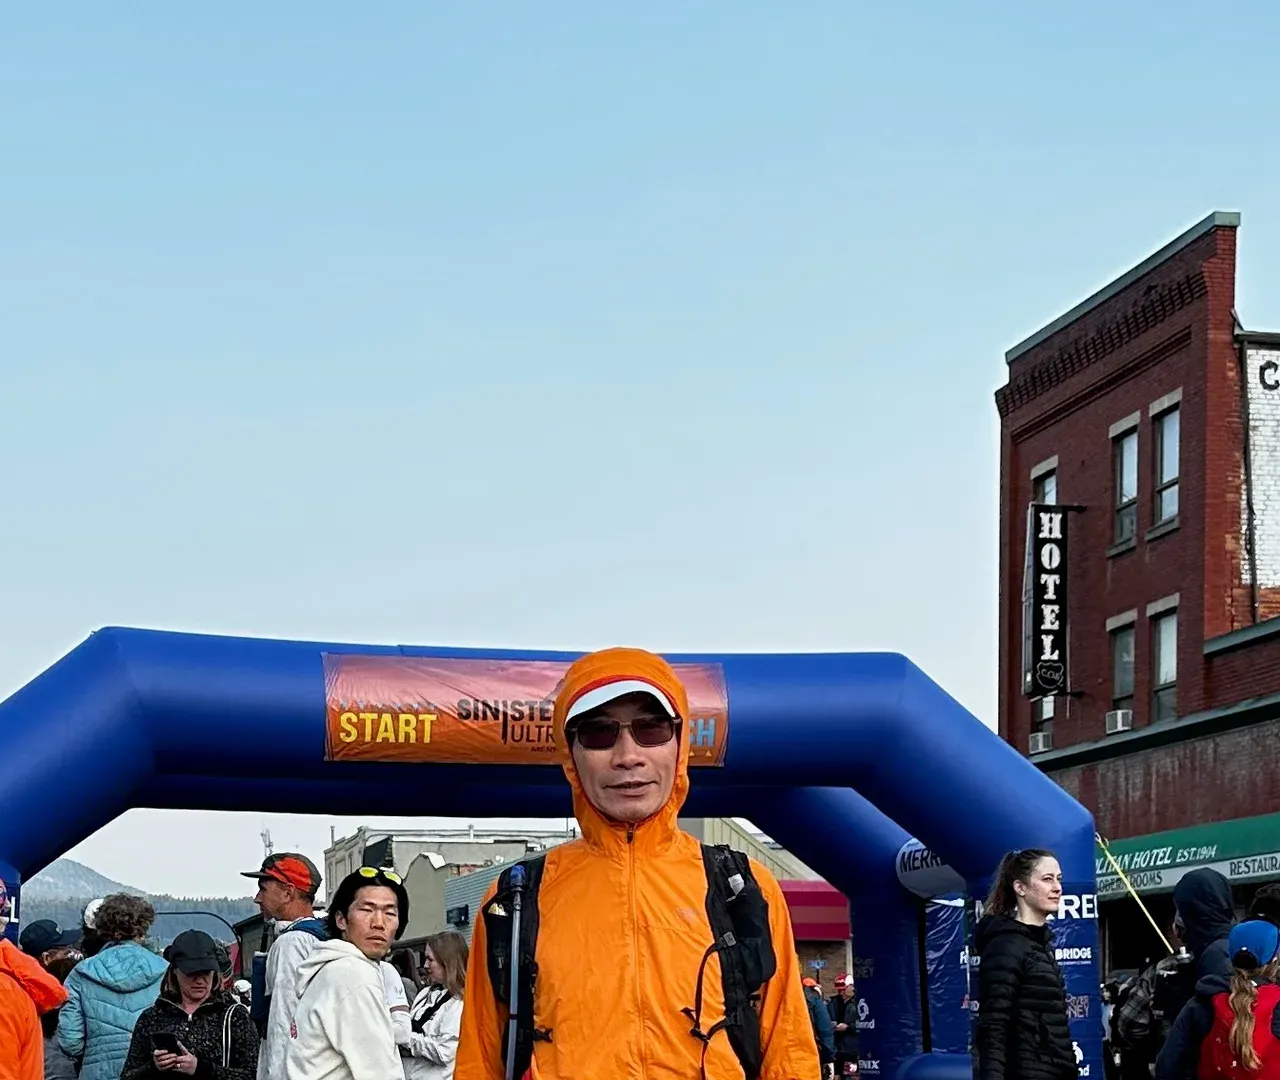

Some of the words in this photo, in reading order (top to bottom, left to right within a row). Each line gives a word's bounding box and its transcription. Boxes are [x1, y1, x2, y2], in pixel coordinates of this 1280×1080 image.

[1038, 512, 1063, 660] HOTEL
[339, 712, 438, 744] START
[457, 699, 556, 745] SINISTE
[511, 724, 556, 743] ULTR
[1130, 846, 1173, 870] HOTEL
